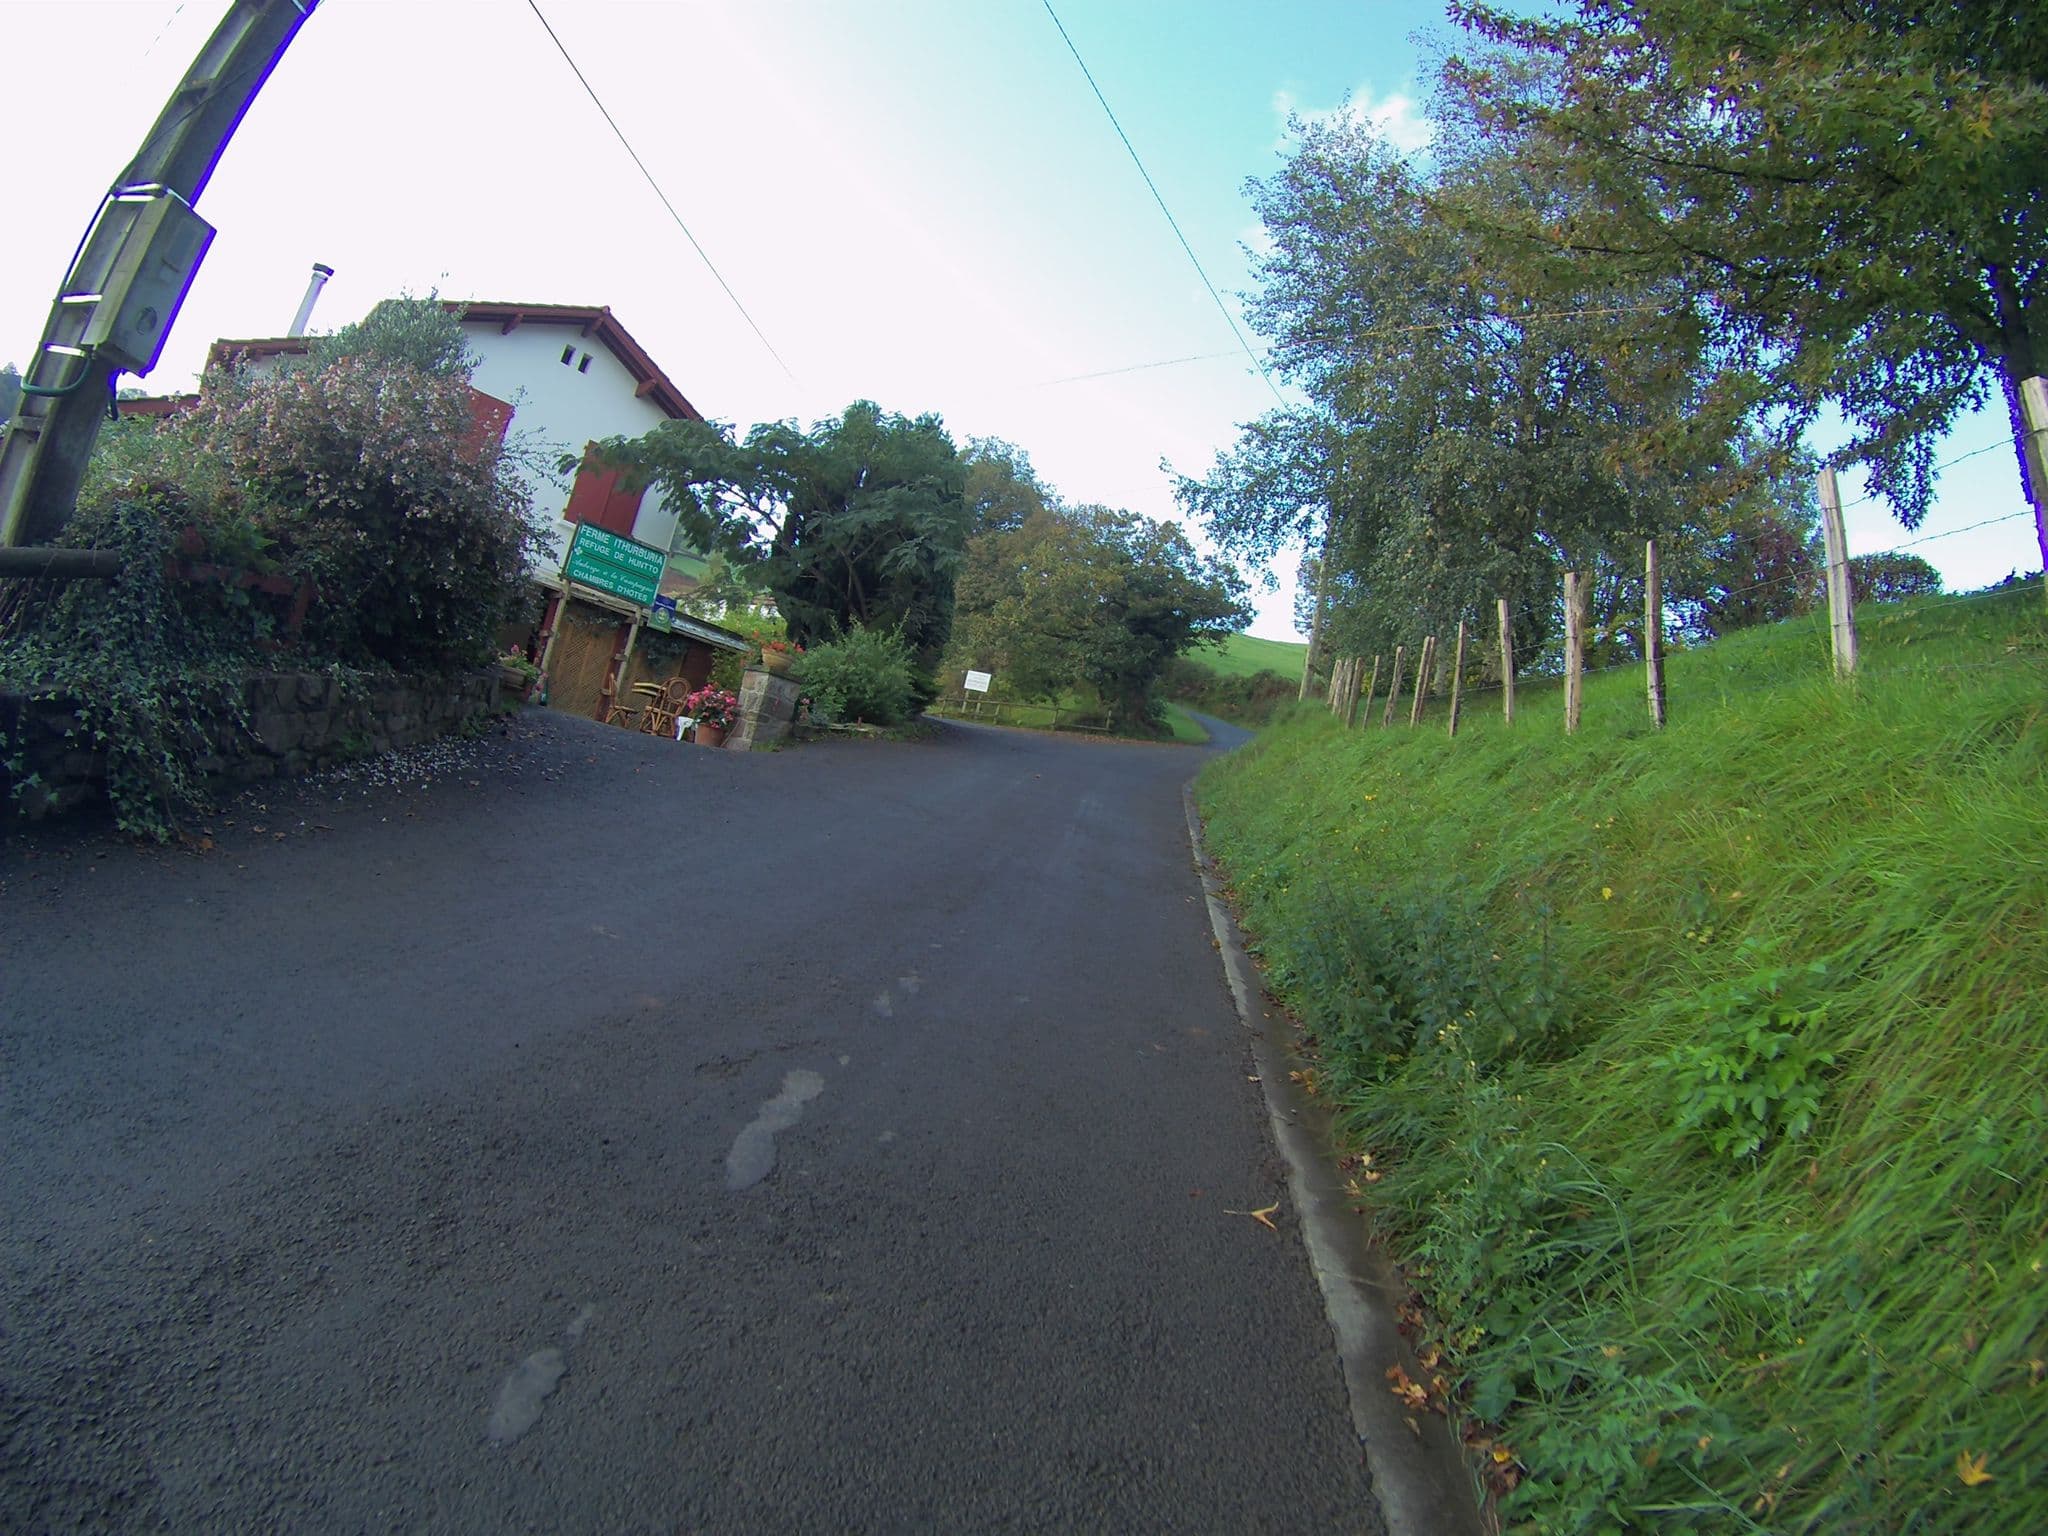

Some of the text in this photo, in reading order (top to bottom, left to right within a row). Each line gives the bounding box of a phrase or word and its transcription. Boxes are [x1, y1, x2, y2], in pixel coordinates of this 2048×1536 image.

[579, 539, 659, 574] REFUGE DE HUNTTO
[581, 525, 663, 565] FERME ITHURBURIA
[573, 570, 614, 589] CHAMBRES
